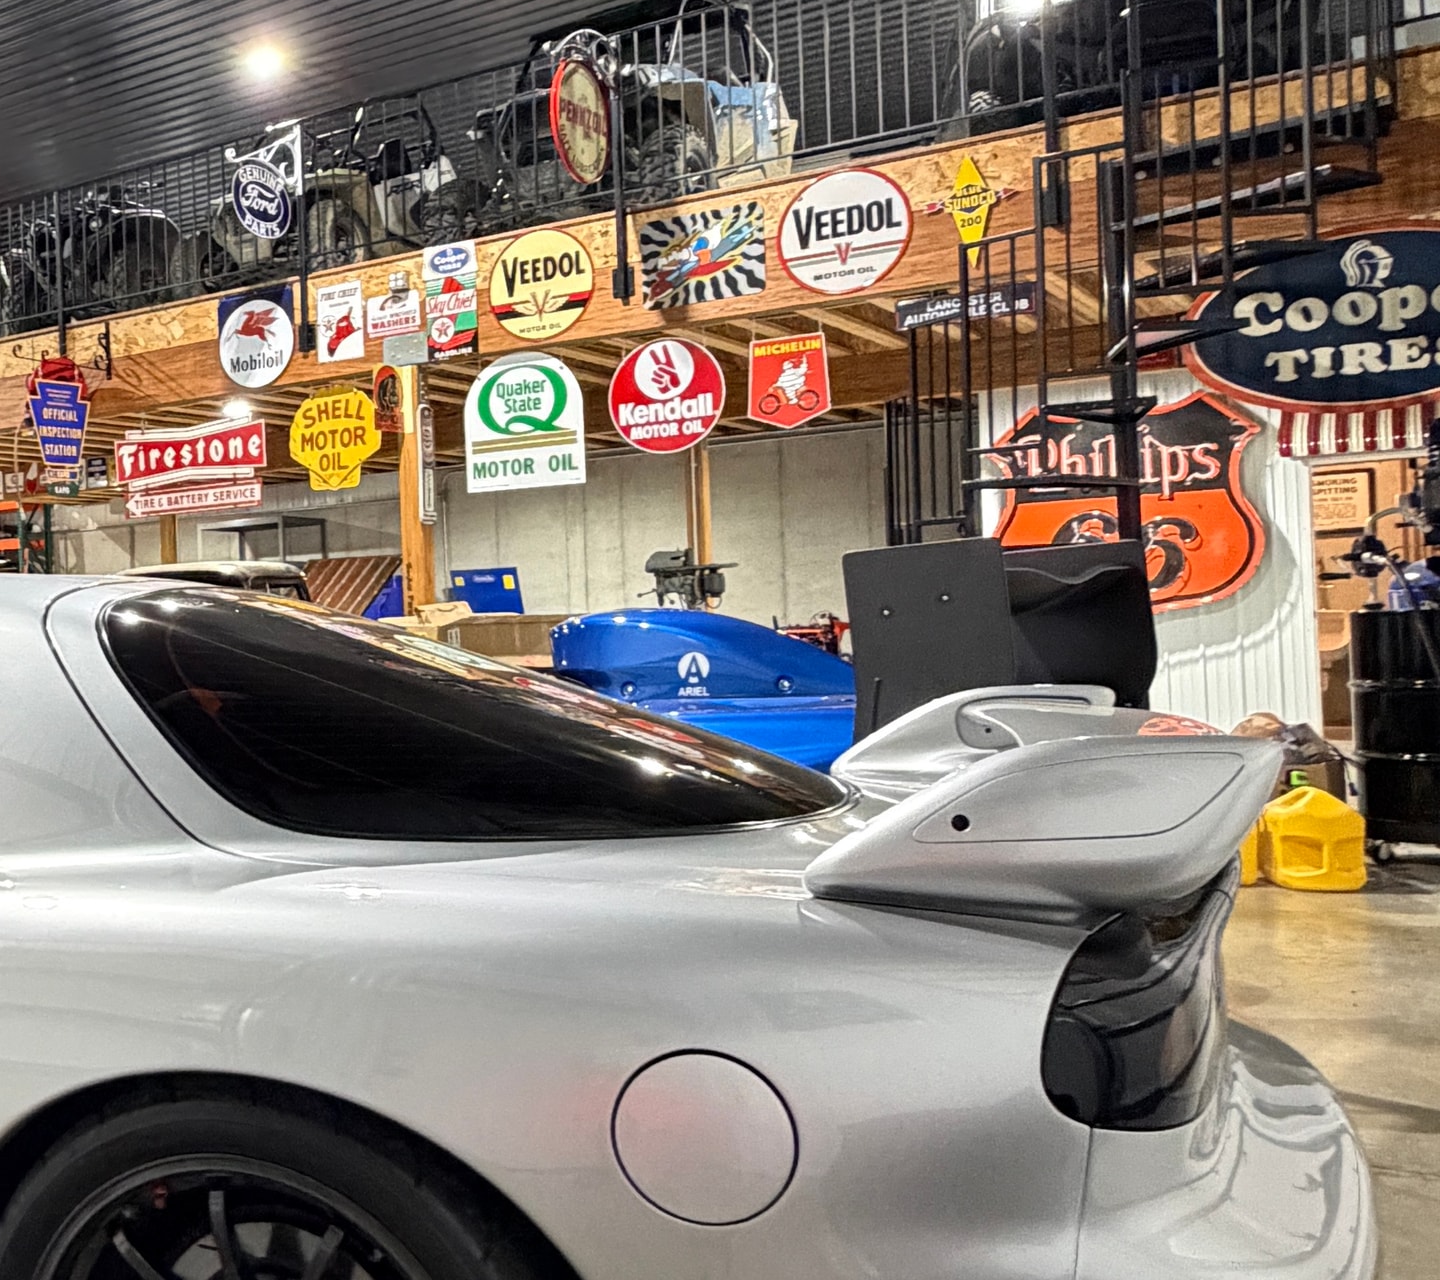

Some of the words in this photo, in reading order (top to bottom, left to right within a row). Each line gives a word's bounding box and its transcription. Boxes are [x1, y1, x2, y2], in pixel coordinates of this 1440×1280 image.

[238, 167, 284, 192] GENUINE
[242, 184, 280, 215] Ford
[944, 190, 997, 213] SUNOCO
[244, 213, 280, 237] PARTS
[792, 197, 902, 250] VEEDOL
[501, 250, 585, 298] VEEDOL
[813, 269, 855, 281] MOTOR
[857, 265, 877, 274] OIL
[320, 291, 336, 302] FIRE
[337, 287, 358, 298] CHIEF
[428, 296, 446, 315] Sky
[447, 289, 475, 311] Chief
[1233, 284, 1440, 337] Coop
[371, 316, 416, 330] WASHERS
[519, 325, 546, 333] MOTOR
[754, 338, 821, 358] MICHELIN
[230, 349, 283, 373] Mobiloil
[496, 379, 546, 399] Quaker
[42, 407, 78, 422] OFFICIAL
[302, 398, 365, 429] SHELL
[504, 397, 541, 414] State
[618, 393, 714, 426] Kendall
[39, 426, 82, 439] INSPECTION
[301, 426, 367, 452] MOTOR
[630, 423, 679, 440] MOTOR
[682, 419, 705, 435] OIL
[45, 443, 77, 457] STATION
[119, 433, 261, 478] Firestone
[319, 452, 349, 471] OIL
[473, 457, 535, 479] MOTOR
[548, 453, 578, 472] OIL
[134, 497, 155, 510] TIRE
[167, 492, 210, 507] BATTERY
[213, 487, 256, 502] SERVICE
[678, 687, 710, 696] ARIEL
